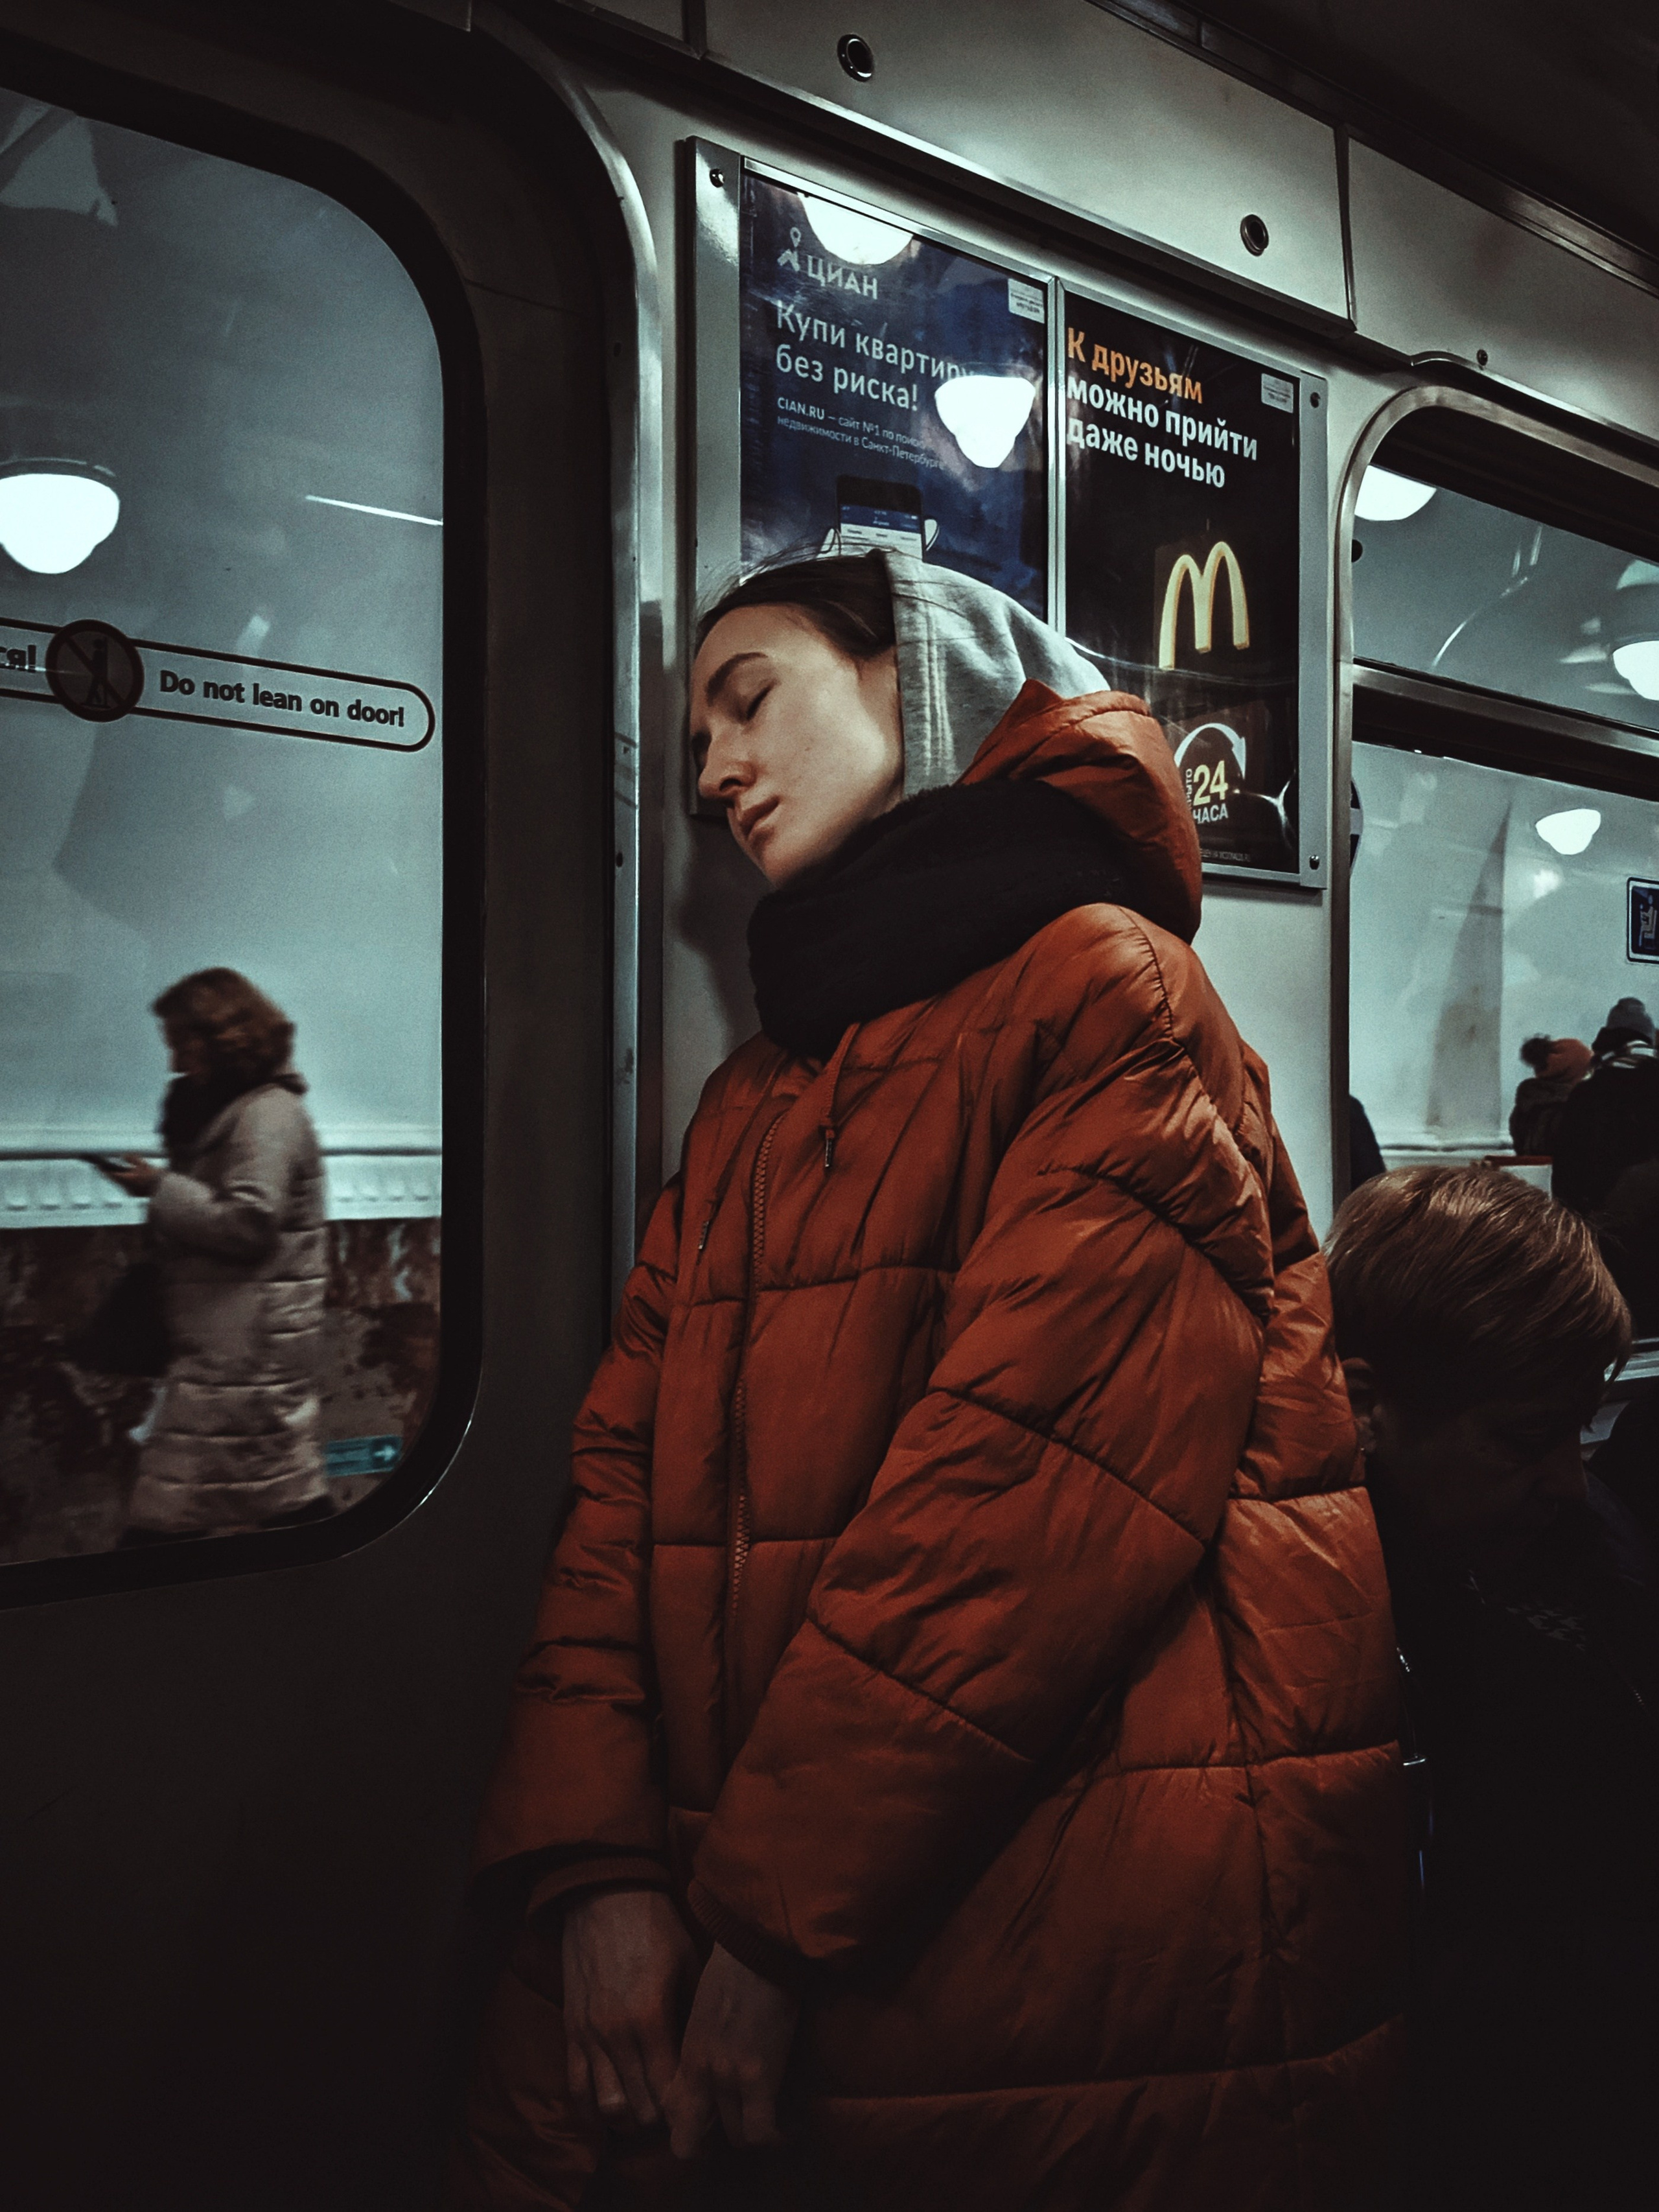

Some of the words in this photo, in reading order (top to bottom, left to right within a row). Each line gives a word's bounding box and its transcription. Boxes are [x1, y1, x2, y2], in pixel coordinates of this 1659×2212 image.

[807, 255, 879, 300] ЦИАН
[777, 300, 846, 348] Купи
[777, 343, 824, 382] без
[834, 367, 918, 411] риска!
[1067, 327, 1085, 363] К
[1092, 344, 1203, 404] друзьям
[778, 397, 824, 420] CIAN.RU
[839, 416, 860, 431] сайт
[863, 421, 880, 436] №1
[882, 429, 894, 441] по
[853, 436, 860, 447] в
[1067, 375, 1159, 428] можно
[1166, 410, 1257, 461] прийти
[1067, 417, 1138, 461] даже
[1144, 442, 1225, 488] ночью
[160, 670, 194, 695] Do
[203, 679, 245, 703] not
[253, 683, 302, 712] lean
[310, 698, 340, 717] on
[347, 699, 405, 727] door!
[1193, 760, 1229, 806] 24
[1193, 803, 1229, 824] ЧАСА
